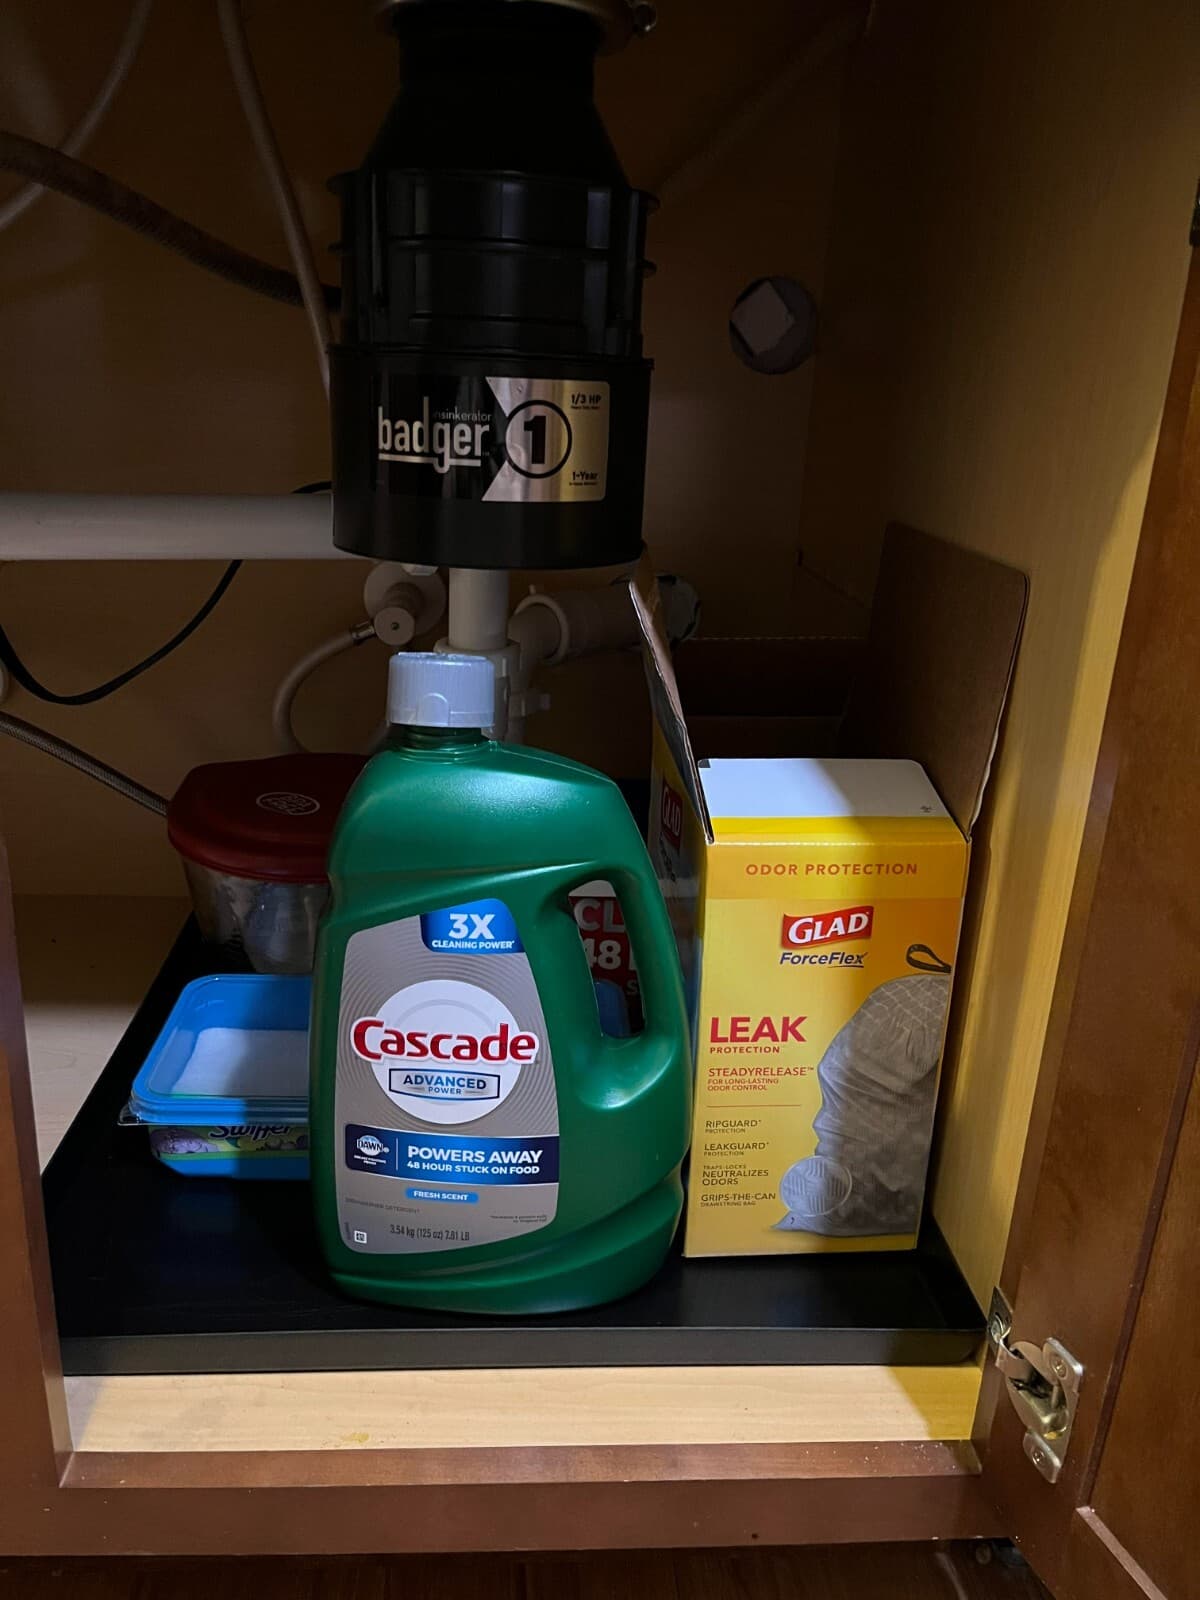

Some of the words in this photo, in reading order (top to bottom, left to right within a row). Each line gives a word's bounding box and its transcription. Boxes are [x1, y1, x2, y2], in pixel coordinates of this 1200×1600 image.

[571, 392, 587, 406] 1/3
[589, 394, 602, 405] HP
[378, 396, 490, 474] badger
[523, 415, 548, 465] 1
[745, 863, 798, 876] ODOR
[804, 863, 918, 876] PROTECTION
[448, 913, 496, 940] 3X
[788, 912, 870, 944] GLAD
[431, 939, 478, 949] CLEANING
[780, 952, 869, 966] ForceFlex
[710, 1016, 808, 1043] LEAK
[352, 1019, 537, 1062] Cascade
[709, 1046, 780, 1054] PROTECTION
[403, 1075, 487, 1090] ADVANCED
[428, 1086, 462, 1095] POWER
[356, 1138, 385, 1152] DAWN
[407, 1145, 486, 1163] POWERS
[488, 1149, 543, 1164] AWAY
[407, 1160, 420, 1170] 48
[422, 1162, 453, 1172] HOUR
[454, 1164, 489, 1174] STUCK
[490, 1166, 508, 1175] ON
[509, 1165, 540, 1175] FOOD
[702, 1169, 769, 1178] NEUTRALIZES
[702, 1178, 739, 1186] ODORS
[413, 1189, 440, 1199] FRESH
[441, 1192, 470, 1201] SCENT
[701, 1192, 776, 1202] GRIPS-THE-CAN
[390, 1223, 405, 1235] 3.54
[406, 1225, 415, 1239] kg
[416, 1227, 431, 1239] (125
[460, 1231, 470, 1241] LB
